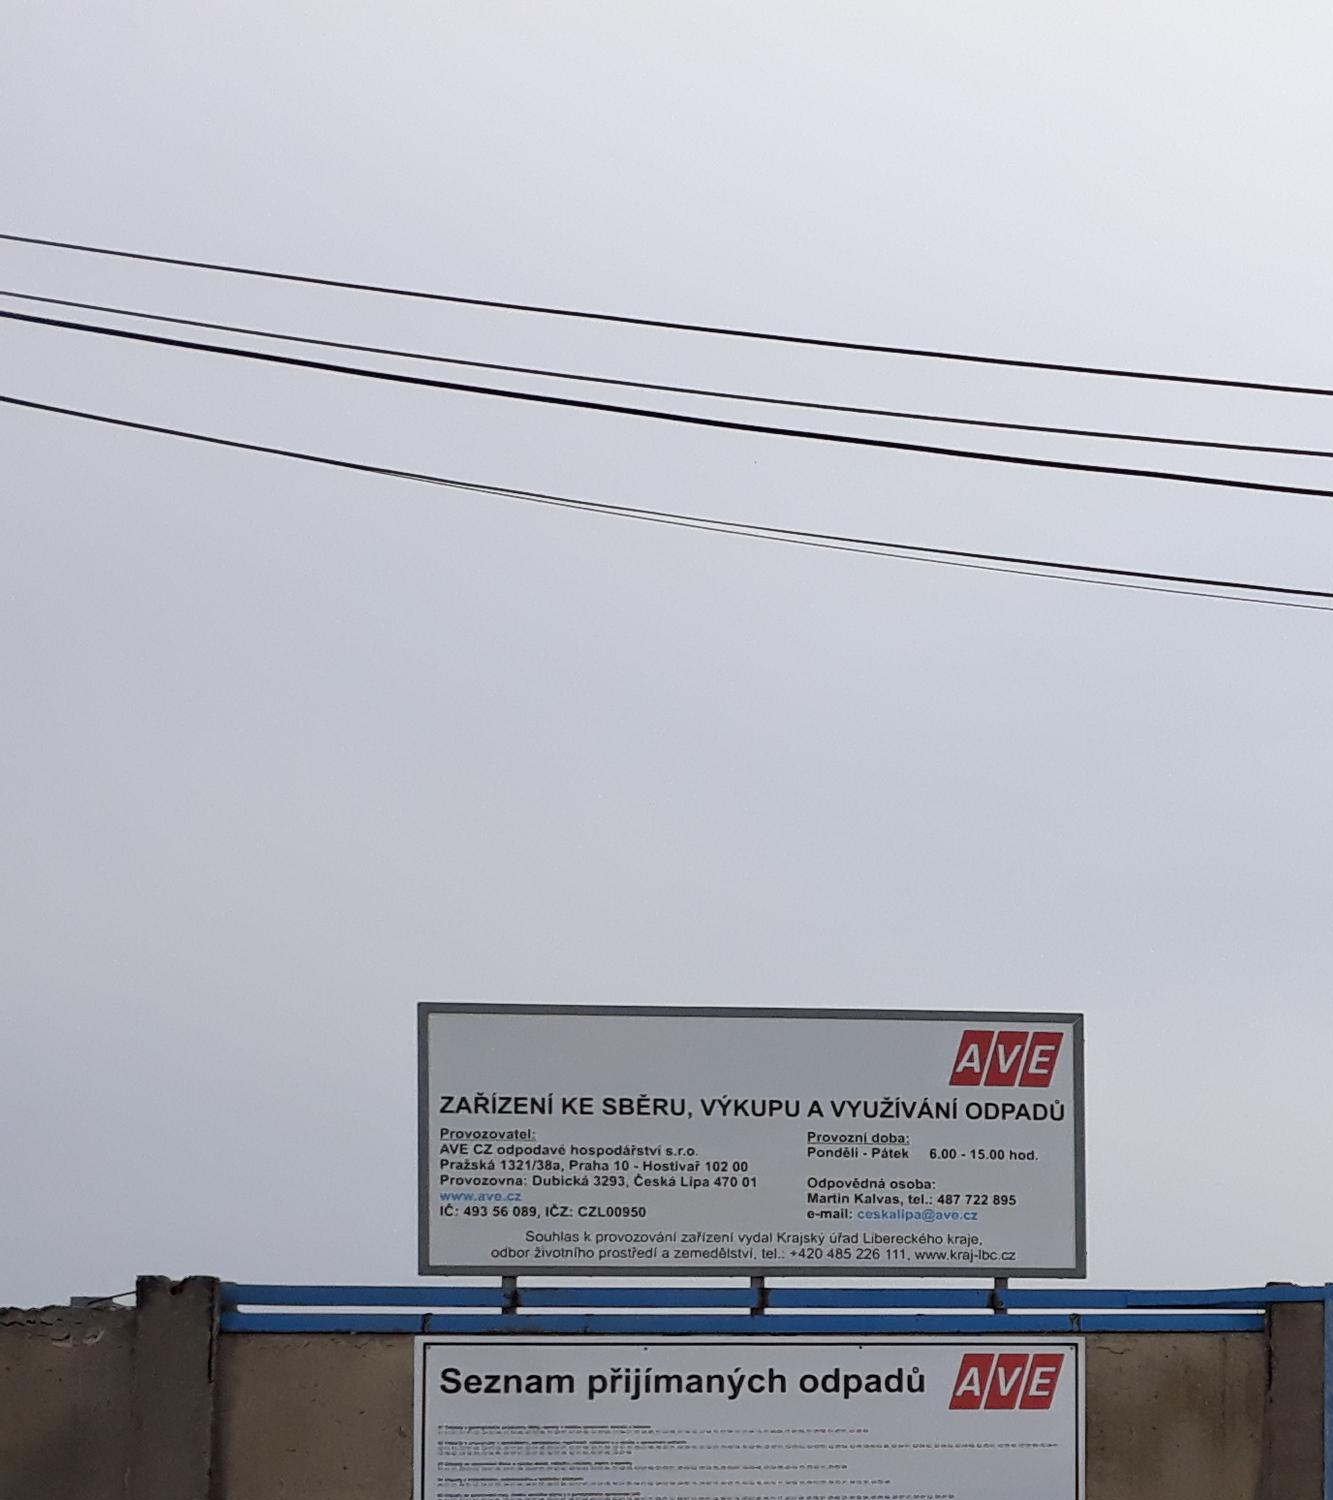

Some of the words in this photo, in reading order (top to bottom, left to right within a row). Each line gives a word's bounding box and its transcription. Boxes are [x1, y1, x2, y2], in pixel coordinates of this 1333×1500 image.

[953, 1041, 1057, 1077] AVE
[439, 1093, 554, 1115] ZAŘÍZENÍ
[561, 1097, 595, 1116] KE
[602, 1095, 694, 1119] SBĚRU,
[700, 1095, 800, 1118] VÝKUPU
[806, 1100, 825, 1118] A
[830, 1096, 958, 1119] VYUŽÍVÁNÍ
[965, 1099, 1066, 1121] ODPADŮ
[439, 1127, 537, 1141] Provozovatel:
[871, 1132, 911, 1146] doba:
[439, 1143, 469, 1155] AVE
[472, 1143, 493, 1155] CZ
[665, 1146, 699, 1158] s.r.o.
[871, 1147, 909, 1159] Pátek
[929, 1148, 957, 1160] 6.00
[970, 1149, 1005, 1161] 15.00
[1009, 1150, 1039, 1161] hod.
[439, 1159, 496, 1172] Pražská
[500, 1160, 565, 1174] 1321/38a,
[568, 1160, 610, 1172] Praha
[613, 1160, 630, 1172] 10
[642, 1161, 701, 1173] Hostivař
[705, 1161, 729, 1173] 102
[732, 1161, 749, 1173] 00
[439, 1174, 528, 1187] Provozovna:
[532, 1174, 589, 1187] Dubická
[593, 1175, 631, 1189] 3293,
[633, 1173, 677, 1188] Česká
[713, 1176, 738, 1189] 470
[741, 1176, 757, 1189] 01
[806, 1176, 886, 1191] Odpovědná
[889, 1178, 937, 1190] osoba:
[439, 1191, 523, 1202] www.ave.cz
[807, 1192, 850, 1204] Martin
[854, 1193, 905, 1207] Kalvas,
[907, 1193, 933, 1205] tel.:
[936, 1194, 961, 1206] 487
[965, 1194, 989, 1206] 722
[992, 1195, 1017, 1206] 895
[439, 1203, 459, 1217] IČ:
[463, 1205, 488, 1217] 493
[492, 1205, 509, 1217] 56
[512, 1205, 542, 1220] 089,
[545, 1204, 573, 1218] IČZ:
[577, 1205, 647, 1218] CZL00950
[806, 1207, 853, 1219] e-mail:
[525, 1230, 580, 1243] Souhlas
[583, 1231, 592, 1243] k
[595, 1231, 677, 1246] provozování
[737, 1232, 773, 1247] vydal
[776, 1231, 826, 1247] Krajský
[829, 1232, 859, 1245] úřad
[863, 1232, 944, 1245] Libereckého
[490, 1246, 531, 1259] odbor
[533, 1246, 595, 1259] životního
[598, 1246, 658, 1261] prostředí
[661, 1249, 670, 1259] a
[789, 1248, 824, 1260] +420
[826, 1248, 852, 1260] 485
[855, 1248, 881, 1260] 226
[914, 1249, 1017, 1263] www.kraj-lbc.cz
[439, 1367, 575, 1395] Seznam
[588, 1366, 787, 1401] přijímaných
[799, 1366, 926, 1400] odpadů
[952, 1363, 1058, 1399] AVE
